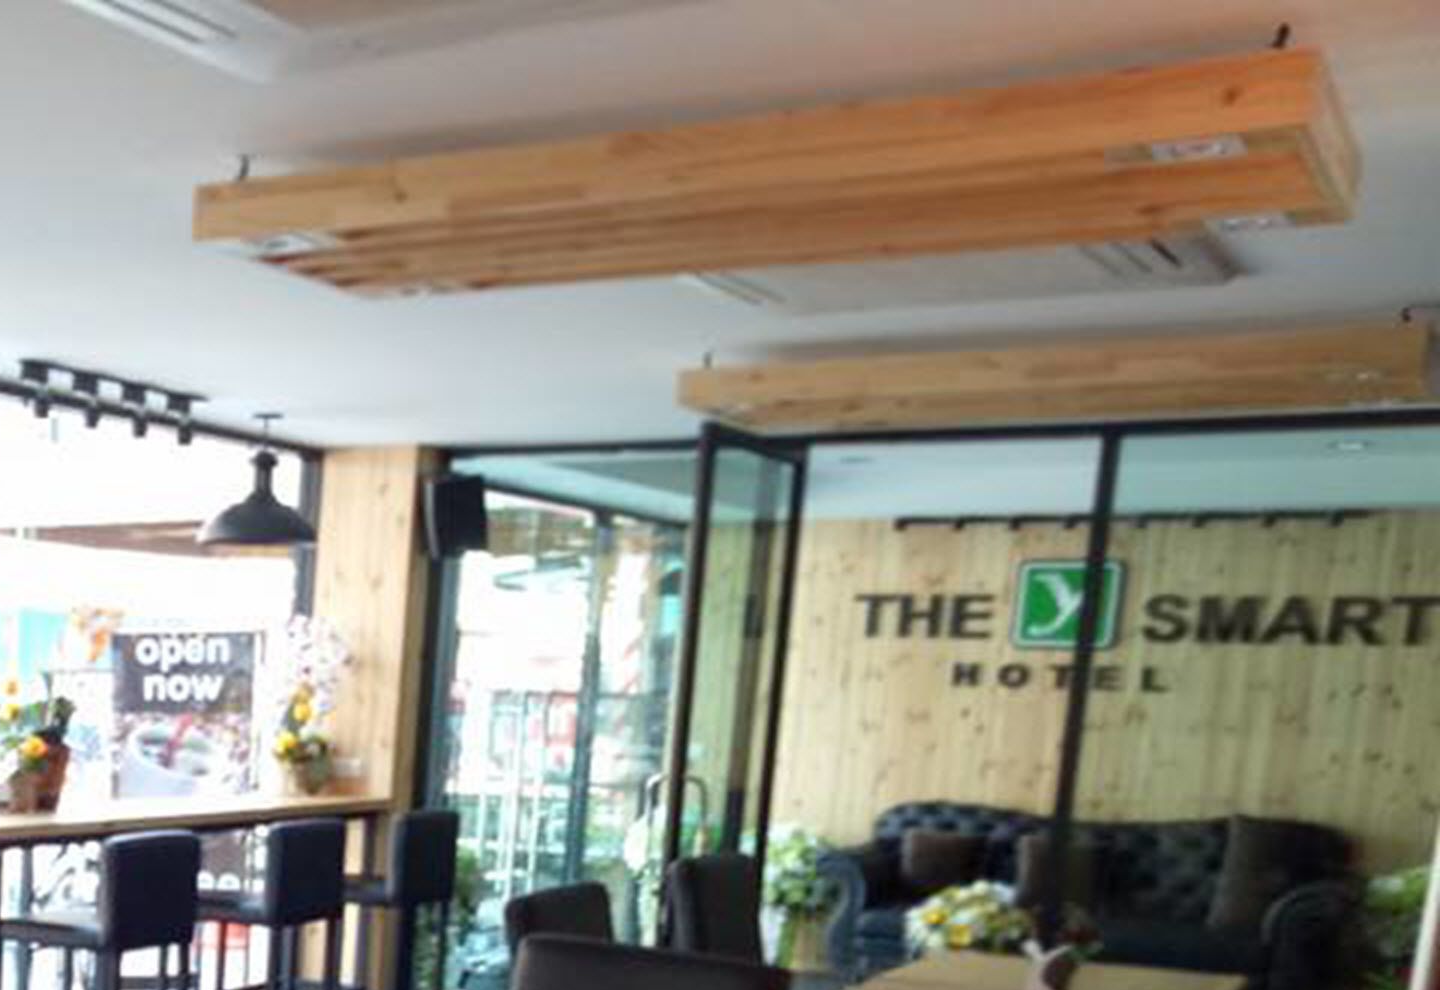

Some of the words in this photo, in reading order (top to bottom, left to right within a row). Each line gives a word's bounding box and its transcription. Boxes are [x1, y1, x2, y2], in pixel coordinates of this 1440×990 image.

[854, 593, 994, 639] THE
[1142, 593, 1440, 649] SMART
[135, 637, 230, 673] open
[143, 674, 224, 702] now
[951, 662, 1169, 693] HOTEL
